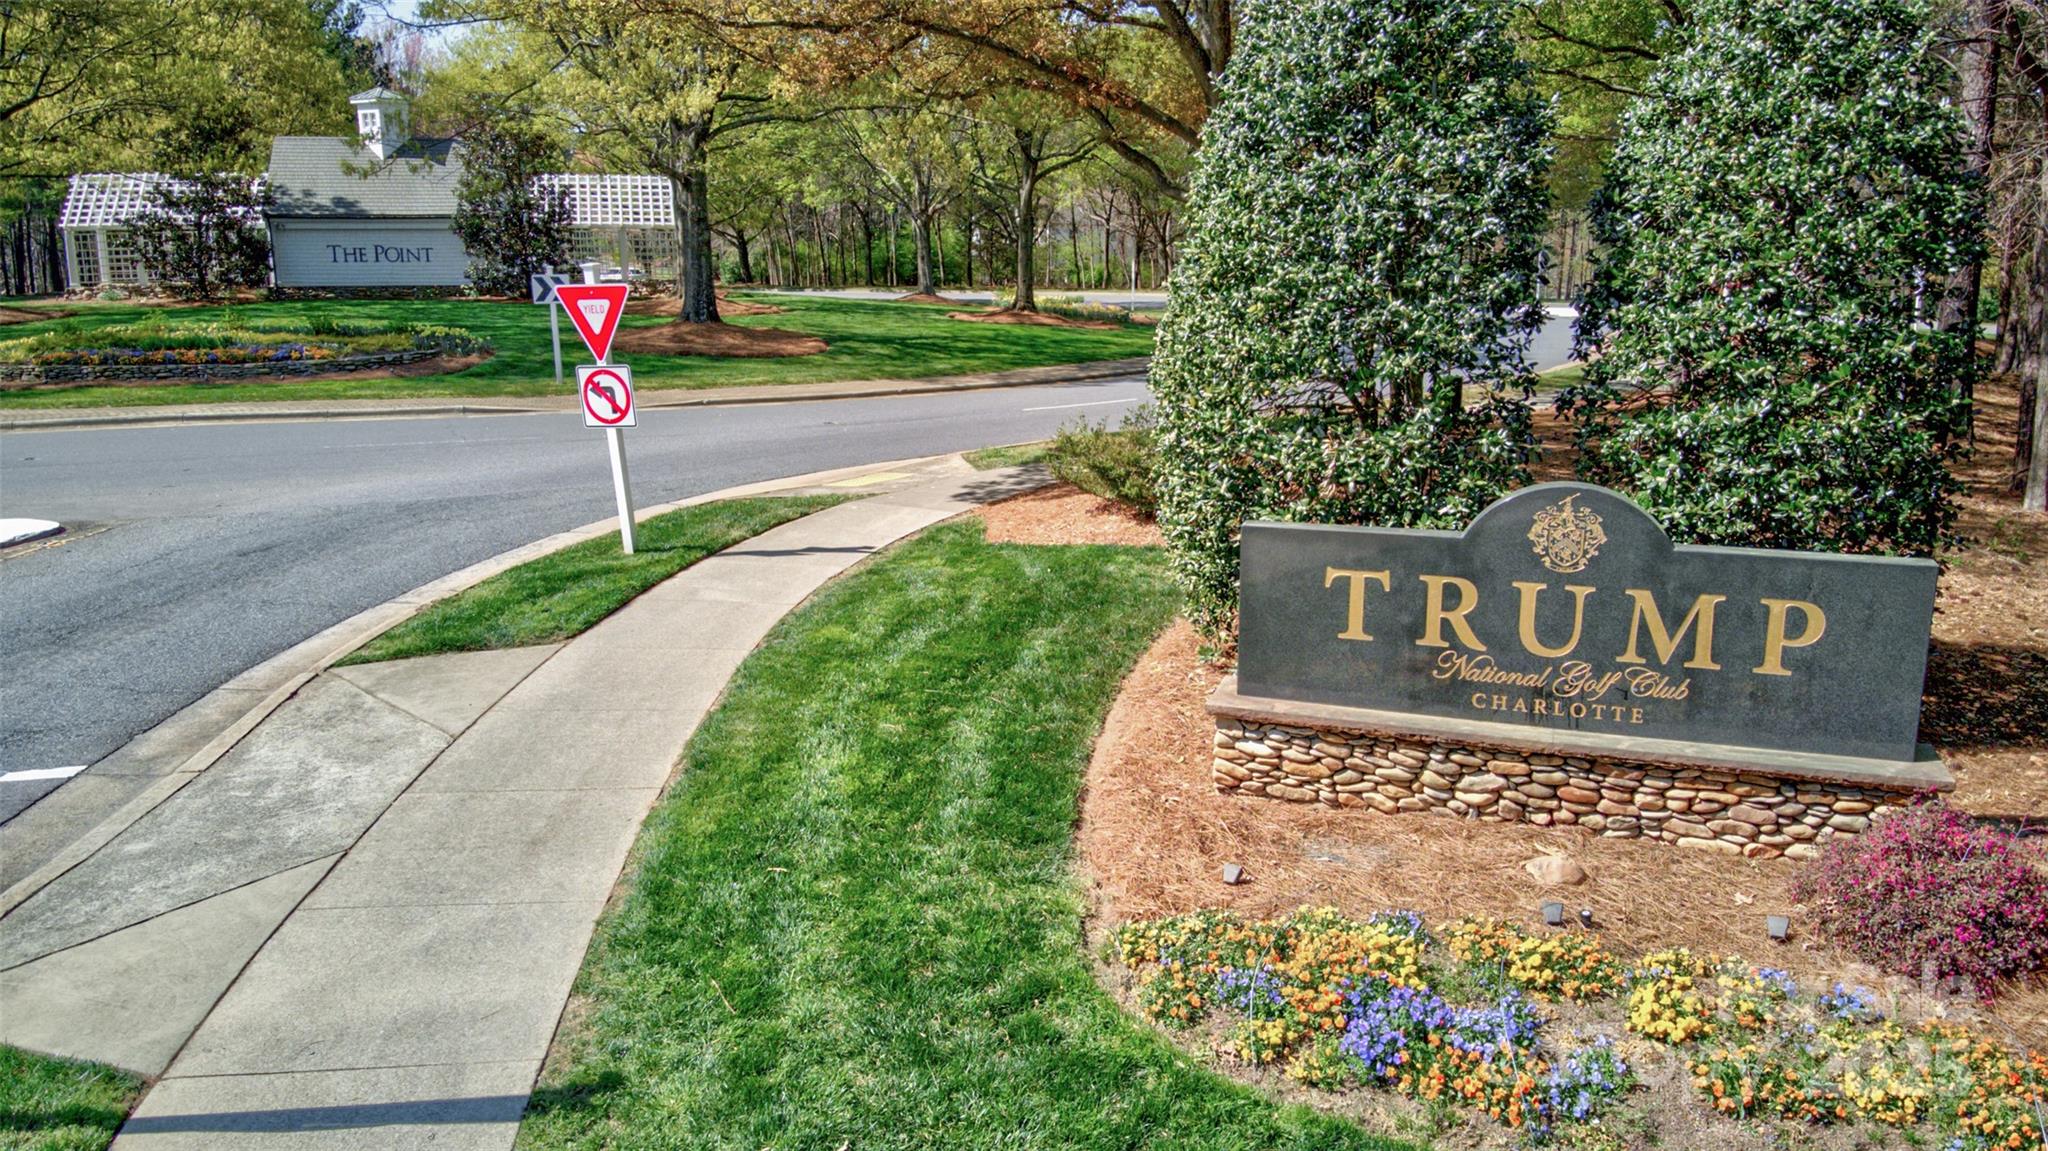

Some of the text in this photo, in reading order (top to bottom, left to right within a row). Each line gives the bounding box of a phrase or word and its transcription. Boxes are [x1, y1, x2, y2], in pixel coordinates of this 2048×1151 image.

[326, 244, 434, 263] THE POINT
[583, 304, 605, 314] YIELD
[1324, 566, 1827, 677] TRUMP
[1432, 650, 1692, 701] National Golf Club
[1471, 692, 1645, 725] CHARLOTTE
